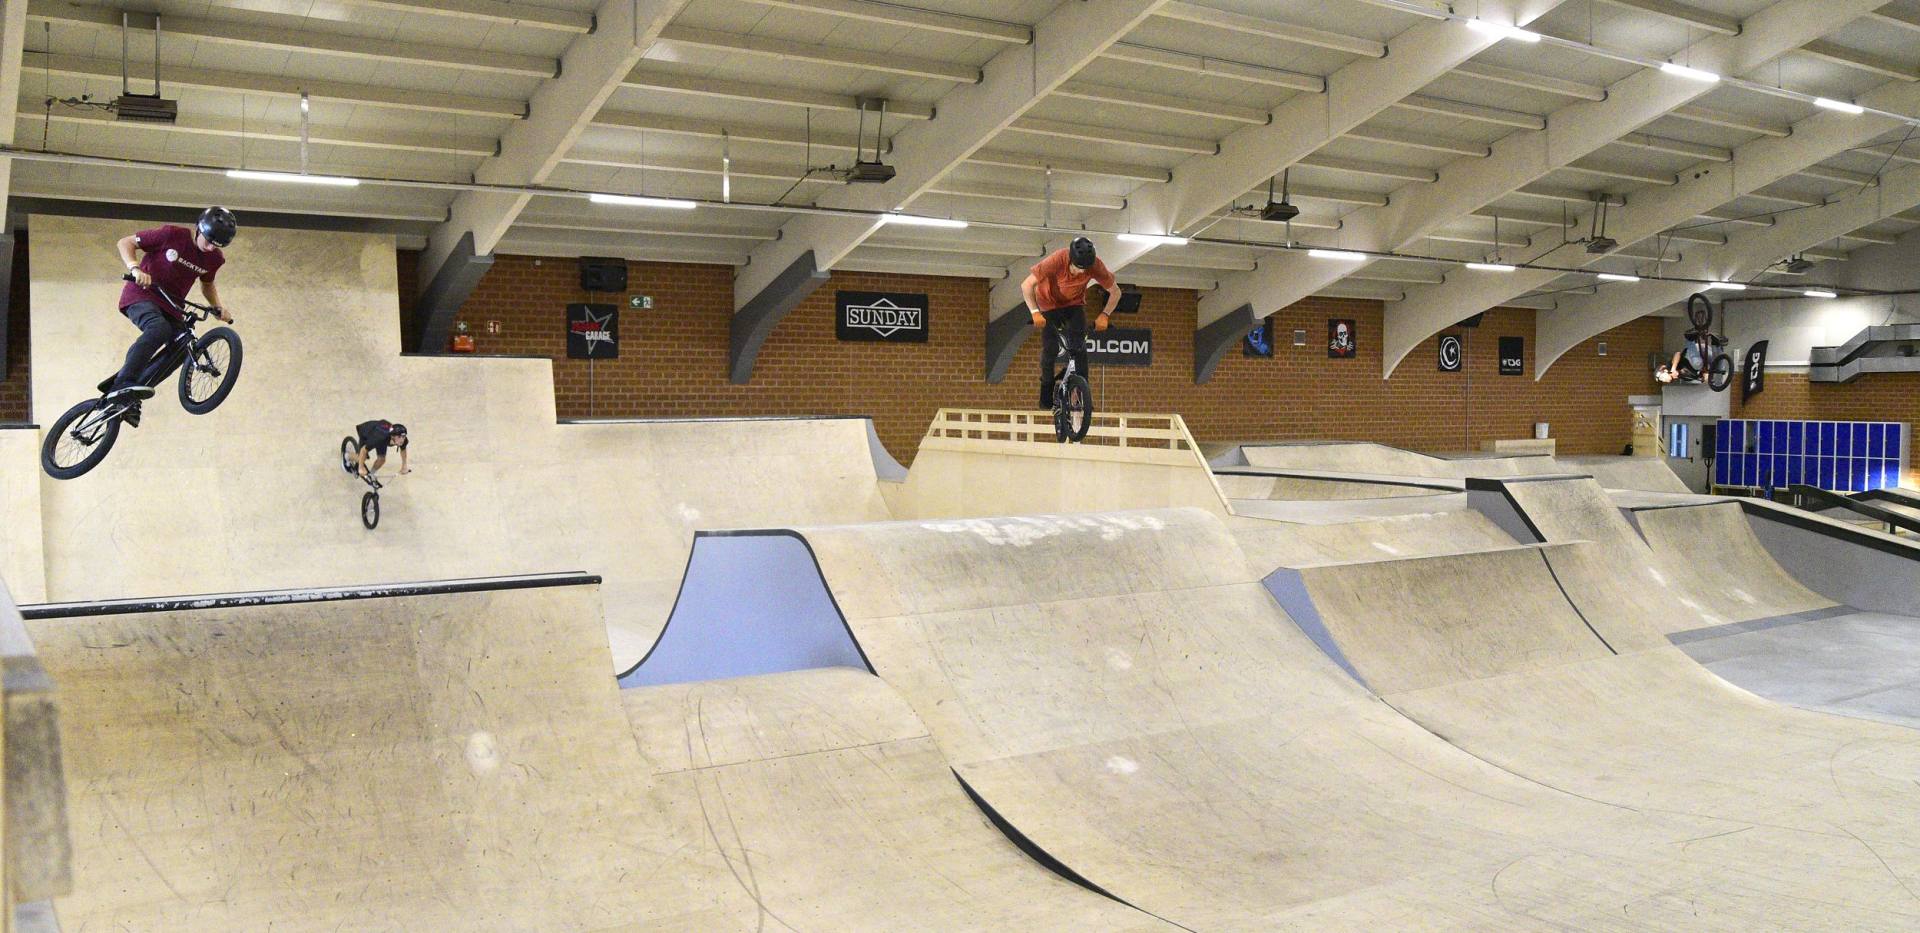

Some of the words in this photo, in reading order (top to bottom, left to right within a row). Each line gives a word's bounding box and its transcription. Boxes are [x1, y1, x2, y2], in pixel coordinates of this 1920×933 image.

[849, 308, 918, 326] SUNDAY
[585, 331, 611, 341] GARAGE
[1085, 338, 1149, 354] OLCOM
